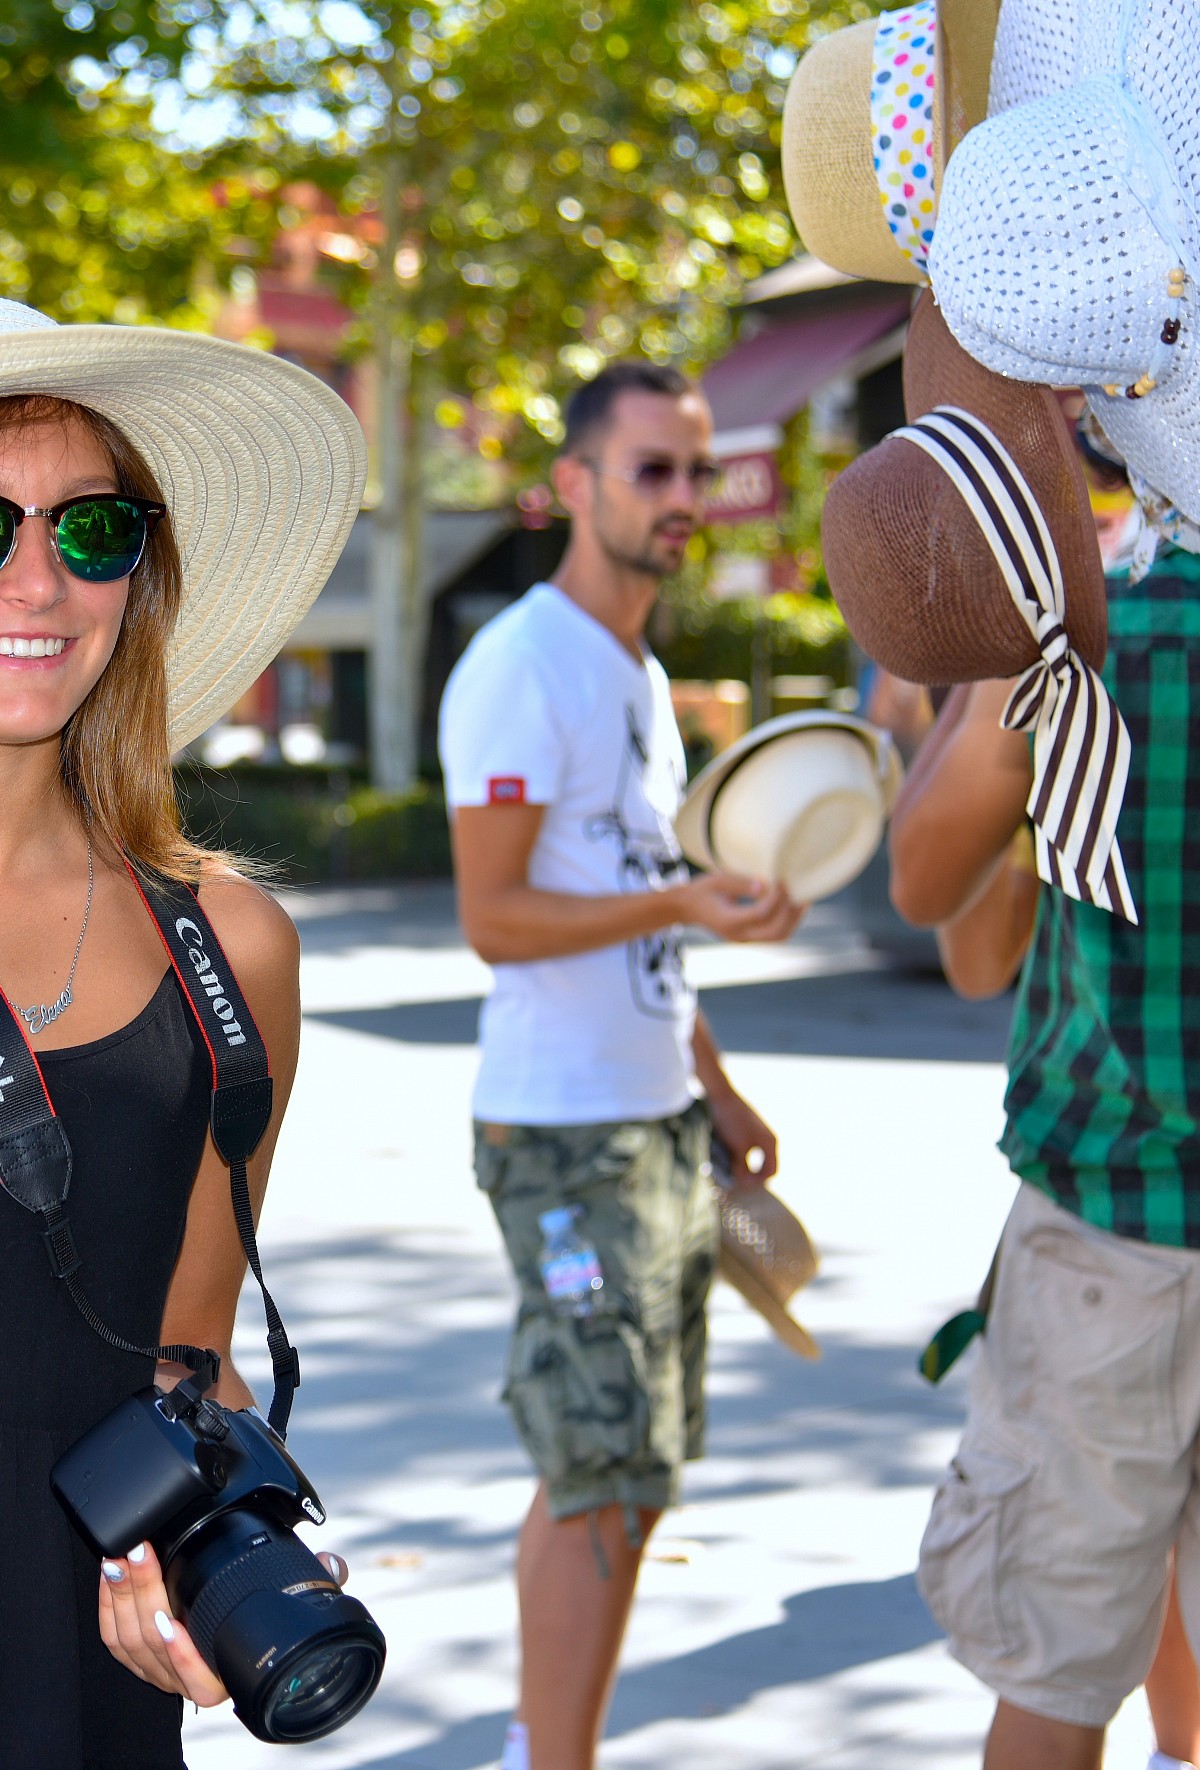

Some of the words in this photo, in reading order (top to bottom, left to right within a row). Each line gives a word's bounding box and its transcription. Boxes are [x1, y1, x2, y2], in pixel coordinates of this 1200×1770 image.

[174, 916, 247, 1048] Canon
[301, 1496, 325, 1524] Canon
[255, 1645, 277, 1670] TAMRON
